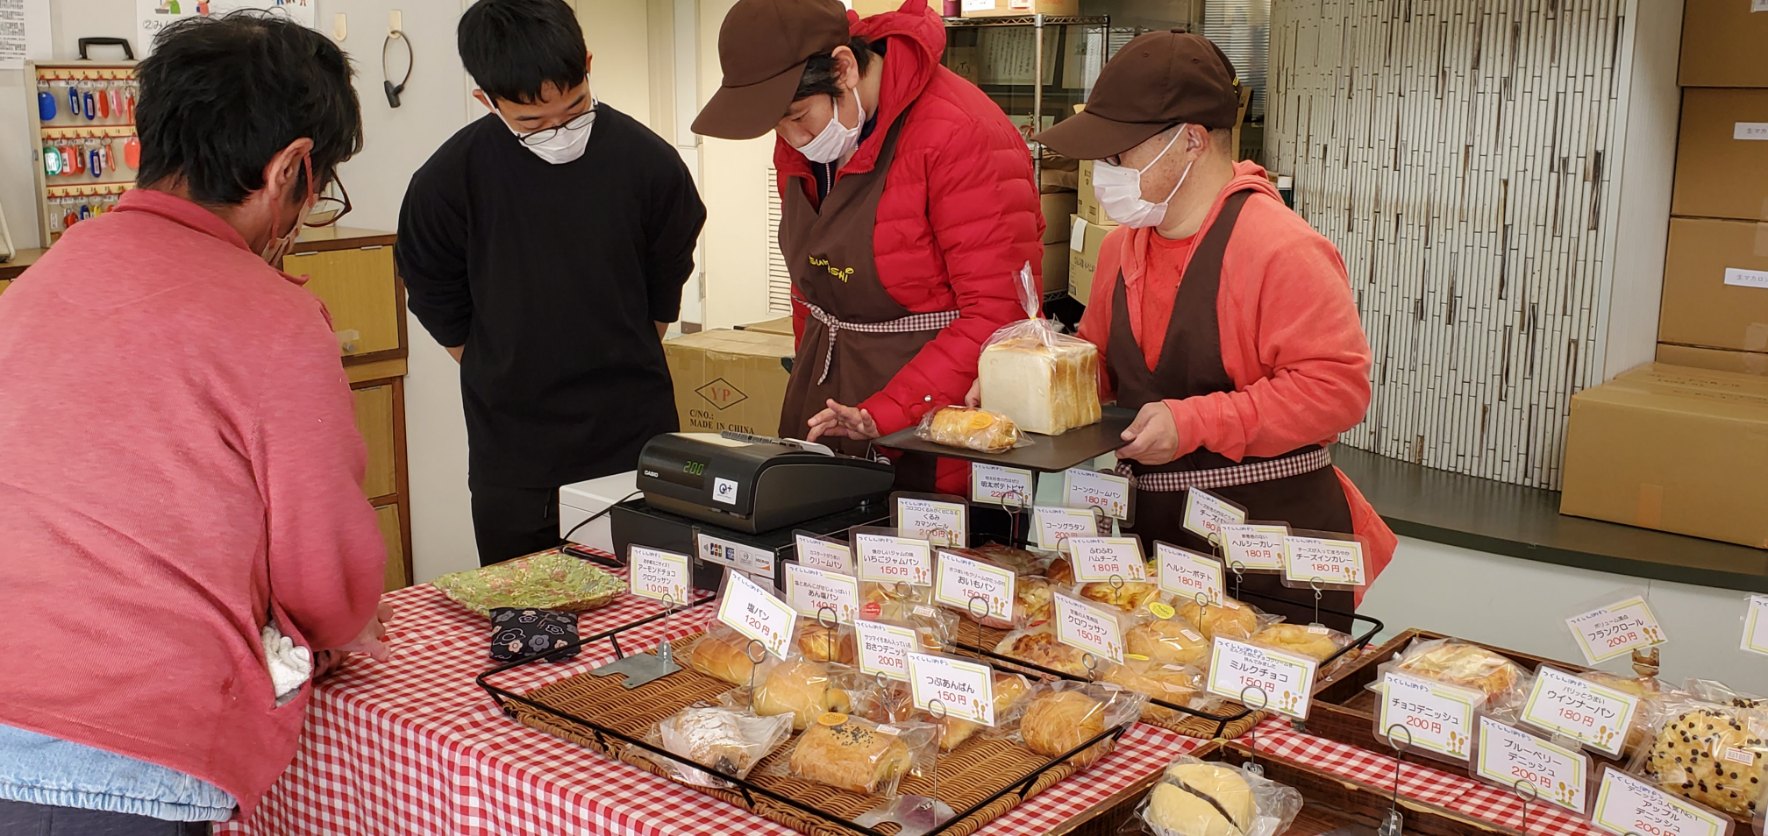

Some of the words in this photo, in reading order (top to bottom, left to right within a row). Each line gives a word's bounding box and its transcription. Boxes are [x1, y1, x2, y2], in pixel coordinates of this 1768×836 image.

[689, 418, 714, 430] MADE
[717, 422, 726, 431] IN
[728, 424, 755, 435] CHINA
[683, 460, 705, 476] 200
[1072, 484, 1121, 499] コーンクリームパン
[1084, 495, 1108, 506] 180円
[914, 520, 950, 530] カマンベール
[923, 513, 940, 521] くるみ
[1045, 522, 1085, 531] コーングラタン
[1089, 547, 1114, 555] ふわふわ
[1231, 540, 1281, 548] ヘルシーカレー
[863, 555, 921, 567] いちごジャムパン
[1245, 549, 1271, 559] 180円
[1296, 553, 1354, 563] チーズインカレー
[638, 563, 676, 577] アーモンドチョコ
[809, 557, 843, 570] クリームパン
[880, 565, 909, 576] 150円
[1091, 563, 1120, 572] 180円
[1311, 563, 1340, 573] 180円
[642, 573, 672, 585] クロワッサン
[1165, 562, 1214, 582] ヘルシーポテト
[645, 583, 669, 594] 100円
[957, 575, 997, 593] おいもパン
[1177, 575, 1203, 590] 180円
[807, 589, 840, 602] あん塩パン
[961, 587, 990, 603] 150円
[746, 602, 770, 622] 塩パン
[810, 599, 838, 612] 140円
[744, 614, 770, 637] 120円
[1067, 614, 1109, 636] クロワッサン
[1587, 619, 1645, 642] フランクロール
[1076, 628, 1103, 645] 150円
[1606, 630, 1639, 648] 200円
[877, 655, 904, 669] 200円
[1229, 660, 1289, 684] ミルクチョコ
[926, 675, 975, 694] つぶあんぱん
[1239, 674, 1276, 693] 150円
[937, 690, 967, 706] 150円
[1562, 686, 1606, 705] パリッとうまい
[1391, 697, 1460, 725] チョコデニッシュ
[1547, 689, 1616, 720] ウインナーパン
[1406, 715, 1443, 735] 200円
[1558, 707, 1596, 728] 180円
[1503, 737, 1563, 766] ブルーベリー
[1508, 751, 1556, 778] デニッシュ
[1511, 765, 1557, 789] 200円
[1642, 799, 1681, 822] アップル
[1635, 807, 1681, 834] デニッシュ
